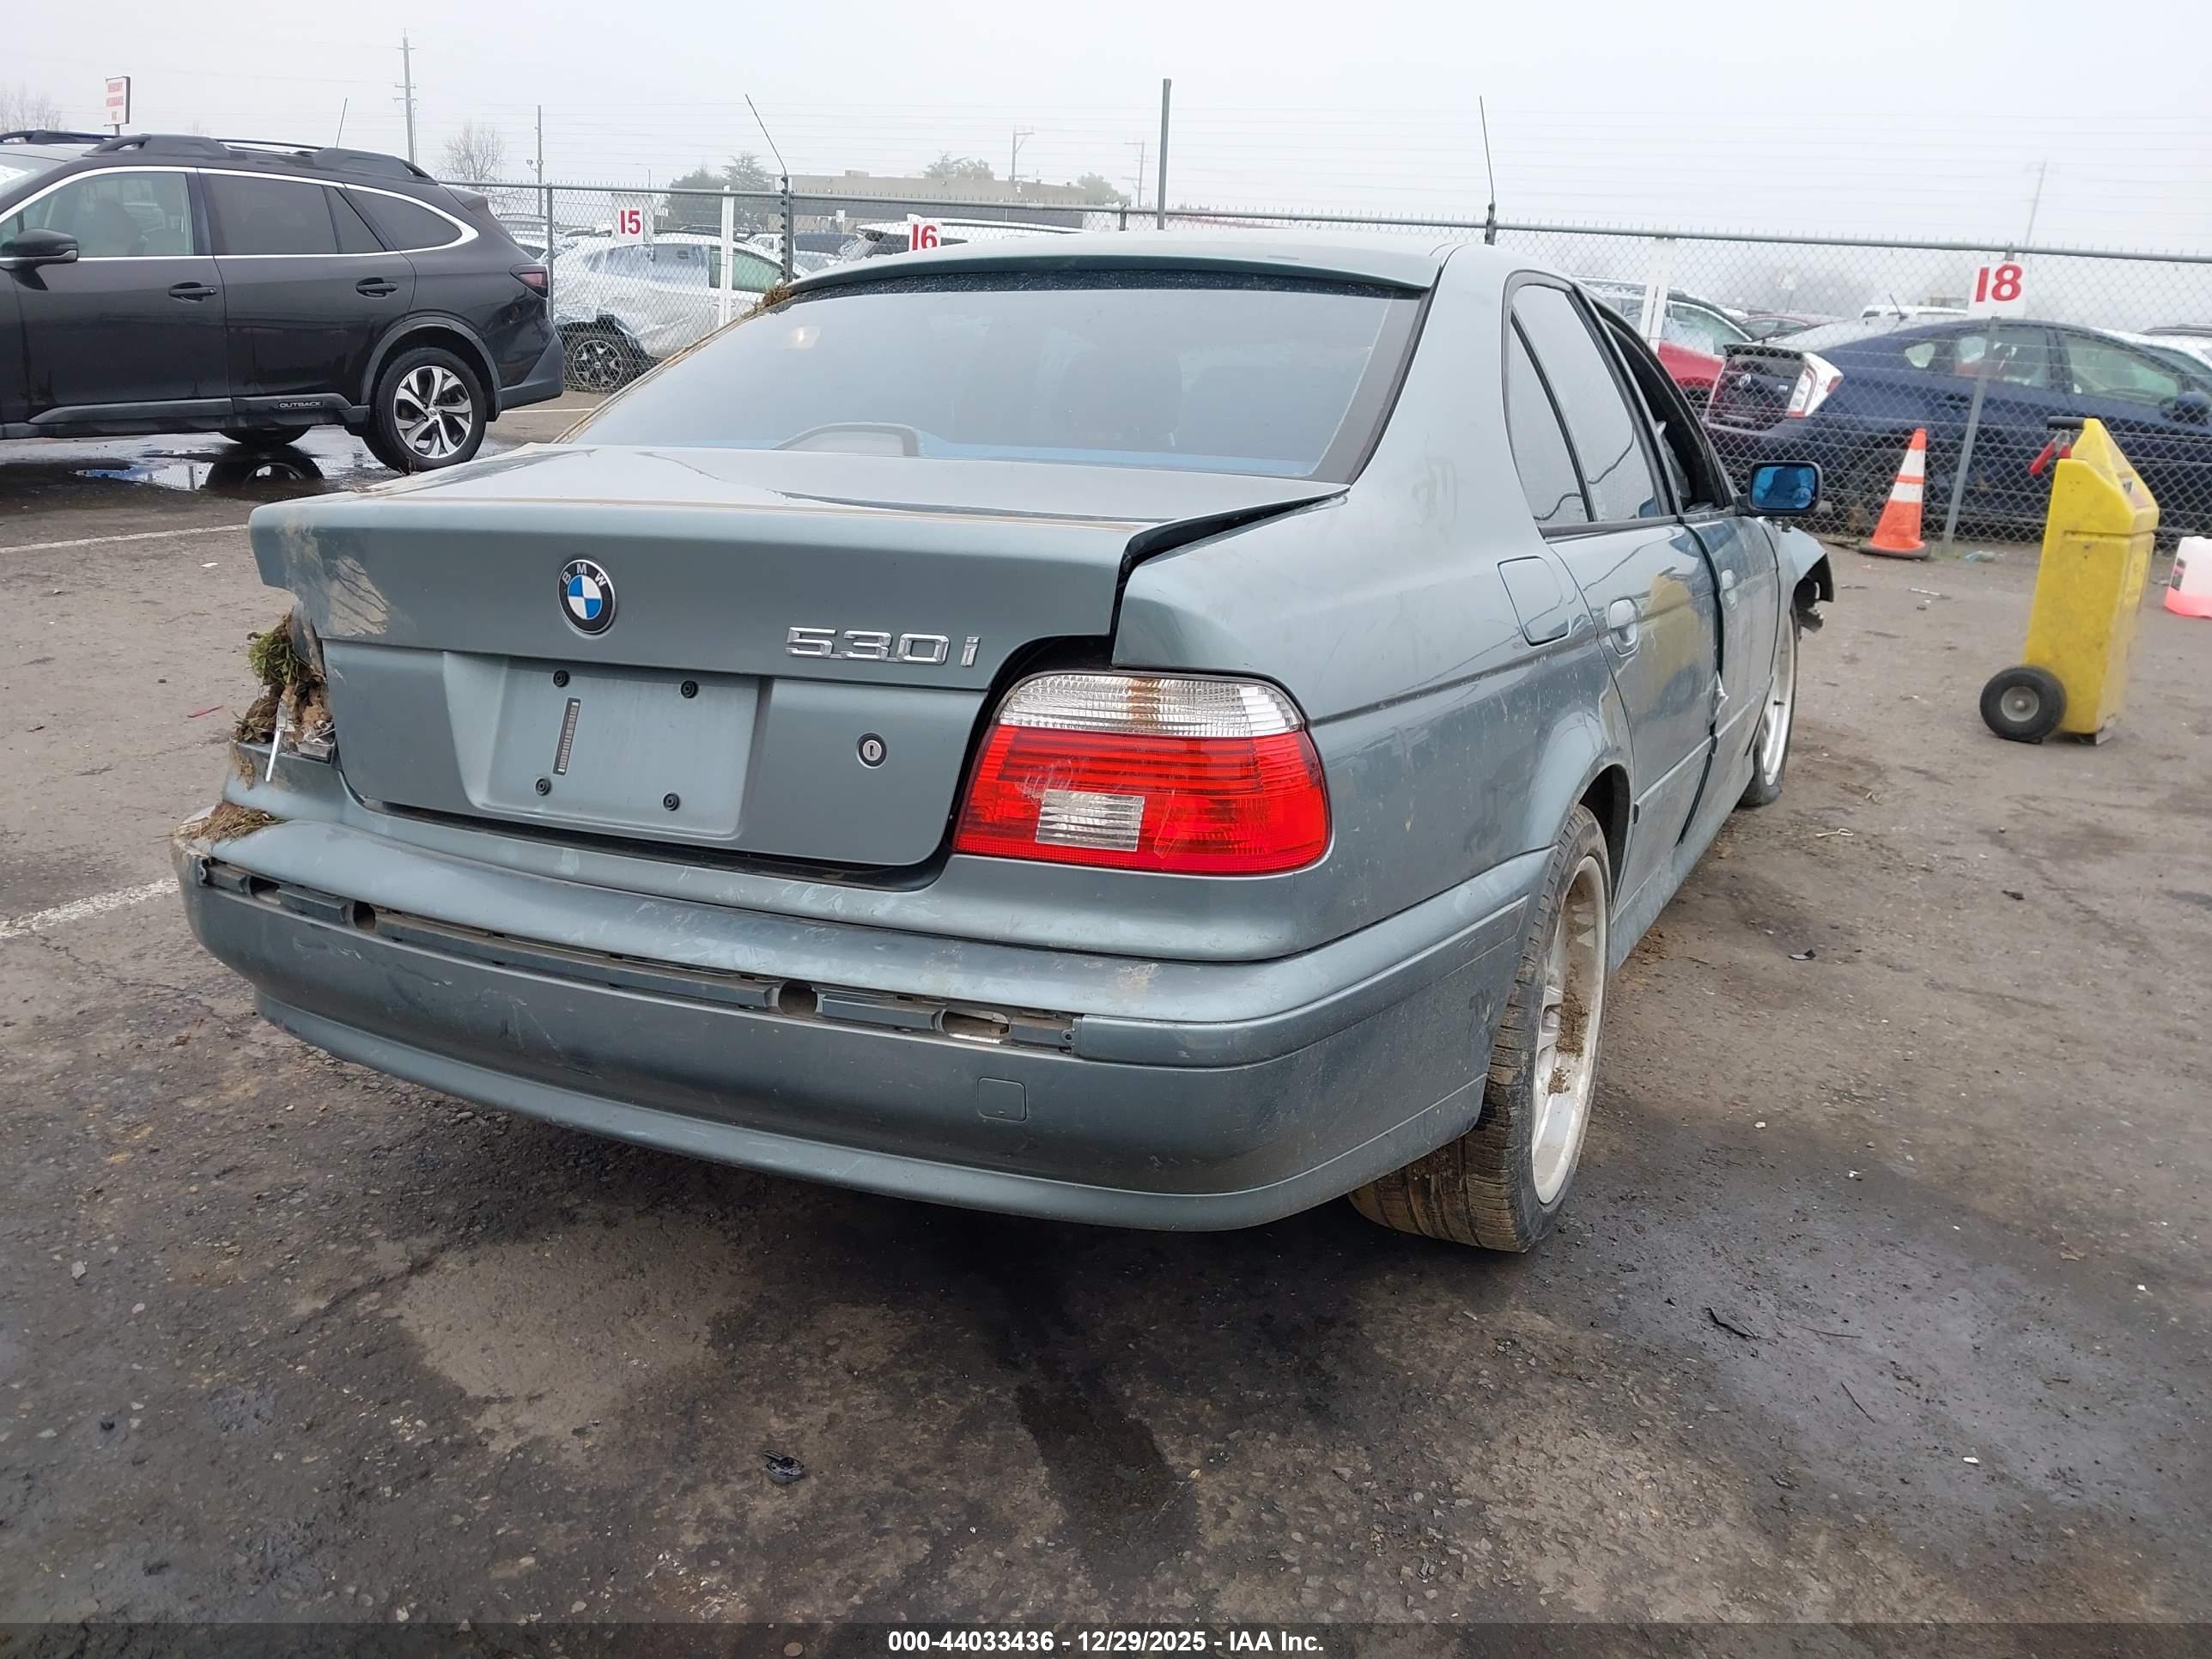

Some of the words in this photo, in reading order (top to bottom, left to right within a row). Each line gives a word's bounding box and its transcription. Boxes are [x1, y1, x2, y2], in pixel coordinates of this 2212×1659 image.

[620, 210, 641, 234] 15
[912, 223, 938, 251] 16
[1975, 264, 2022, 302] 18
[562, 562, 607, 587] BMW
[786, 626, 981, 667] 530i
